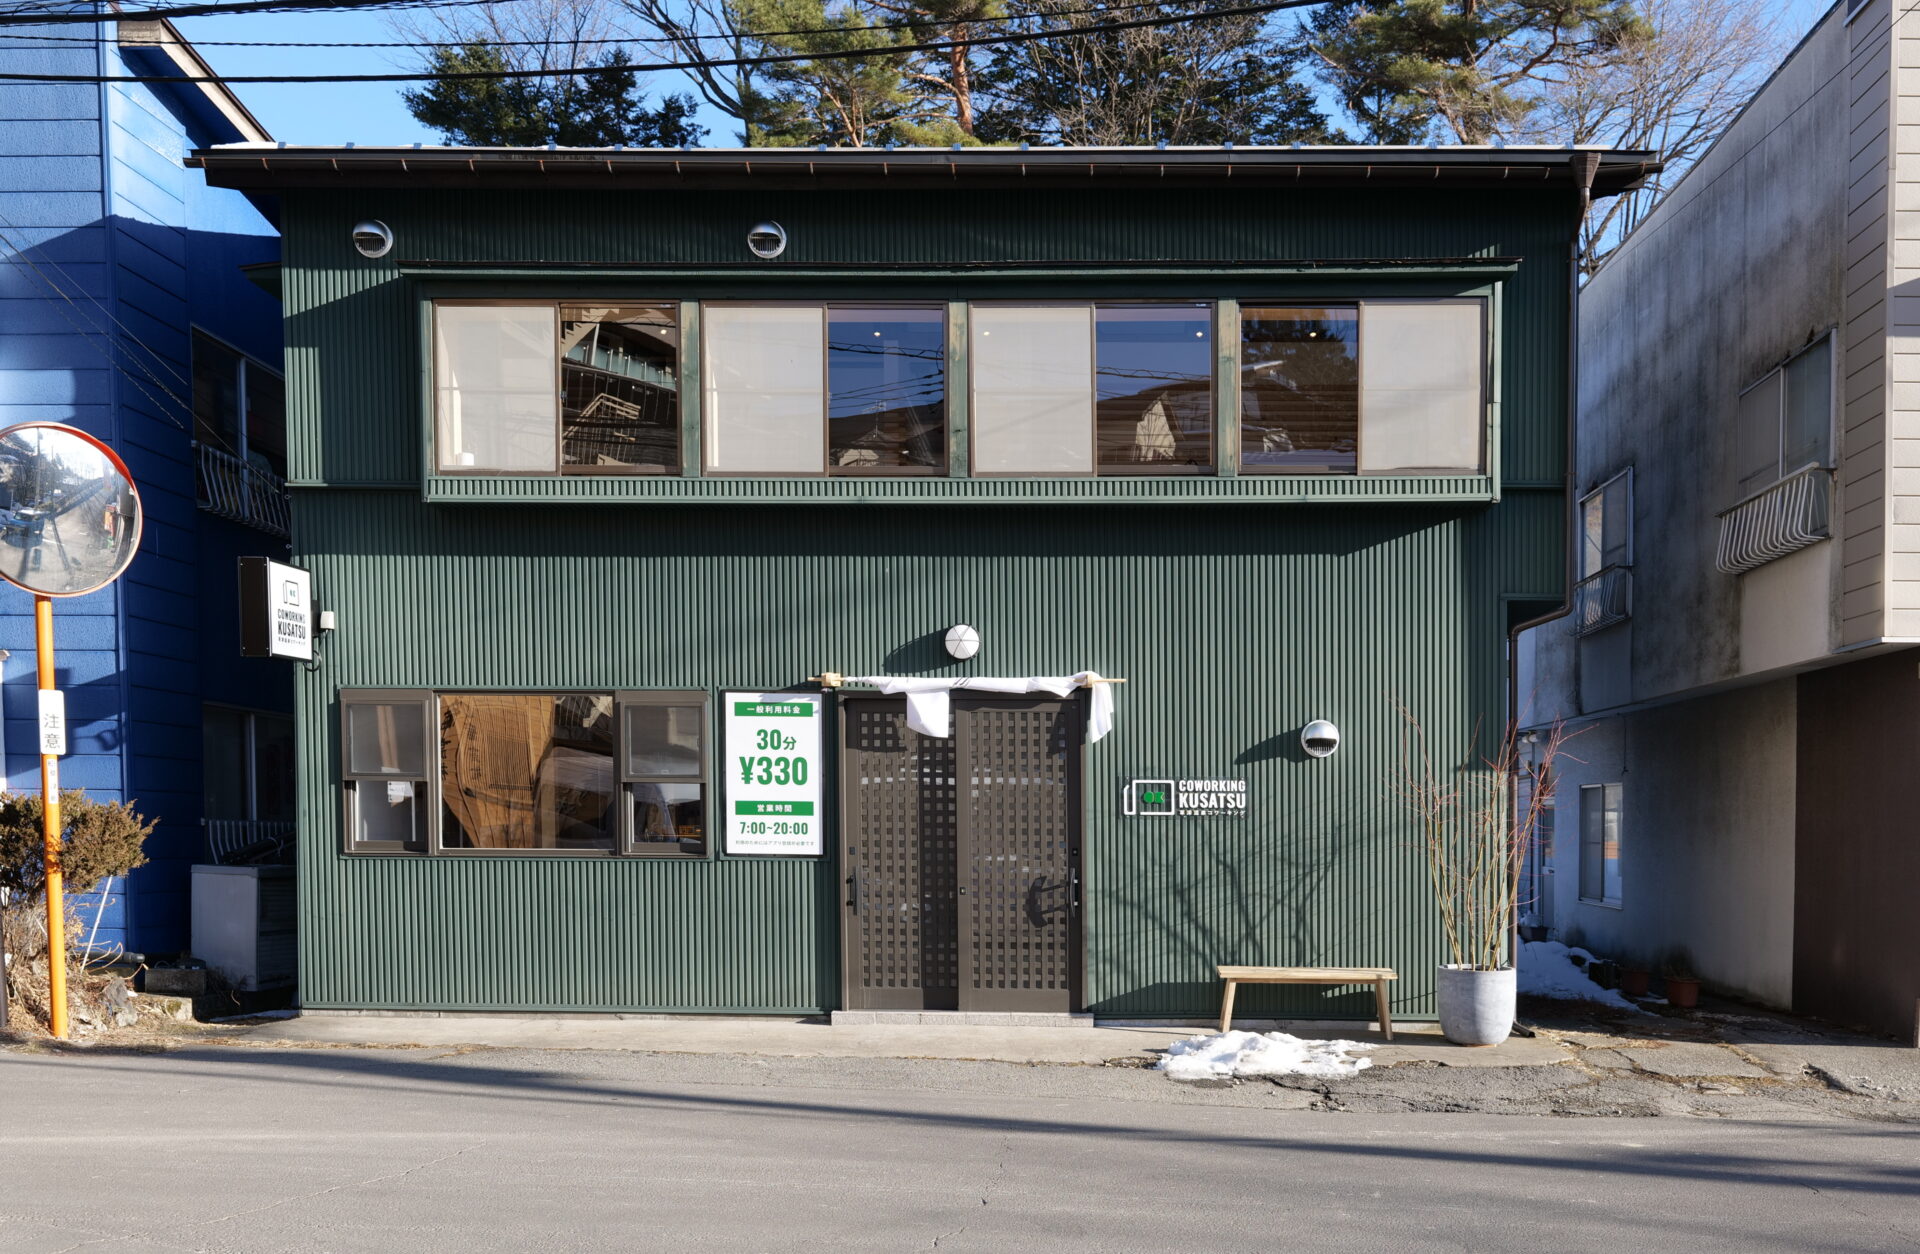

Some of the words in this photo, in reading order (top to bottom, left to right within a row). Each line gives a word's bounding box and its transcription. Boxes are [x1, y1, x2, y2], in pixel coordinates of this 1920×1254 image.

[278, 621, 306, 640] KUSATSU
[746, 705, 801, 714] 一般利用料金
[44, 713, 61, 749] 注意
[756, 729, 797, 750] 30分
[739, 756, 808, 785] ¥330
[1178, 780, 1246, 792] COWORKING
[756, 804, 793, 813] 営業時間
[1178, 793, 1246, 809] KUSATSU
